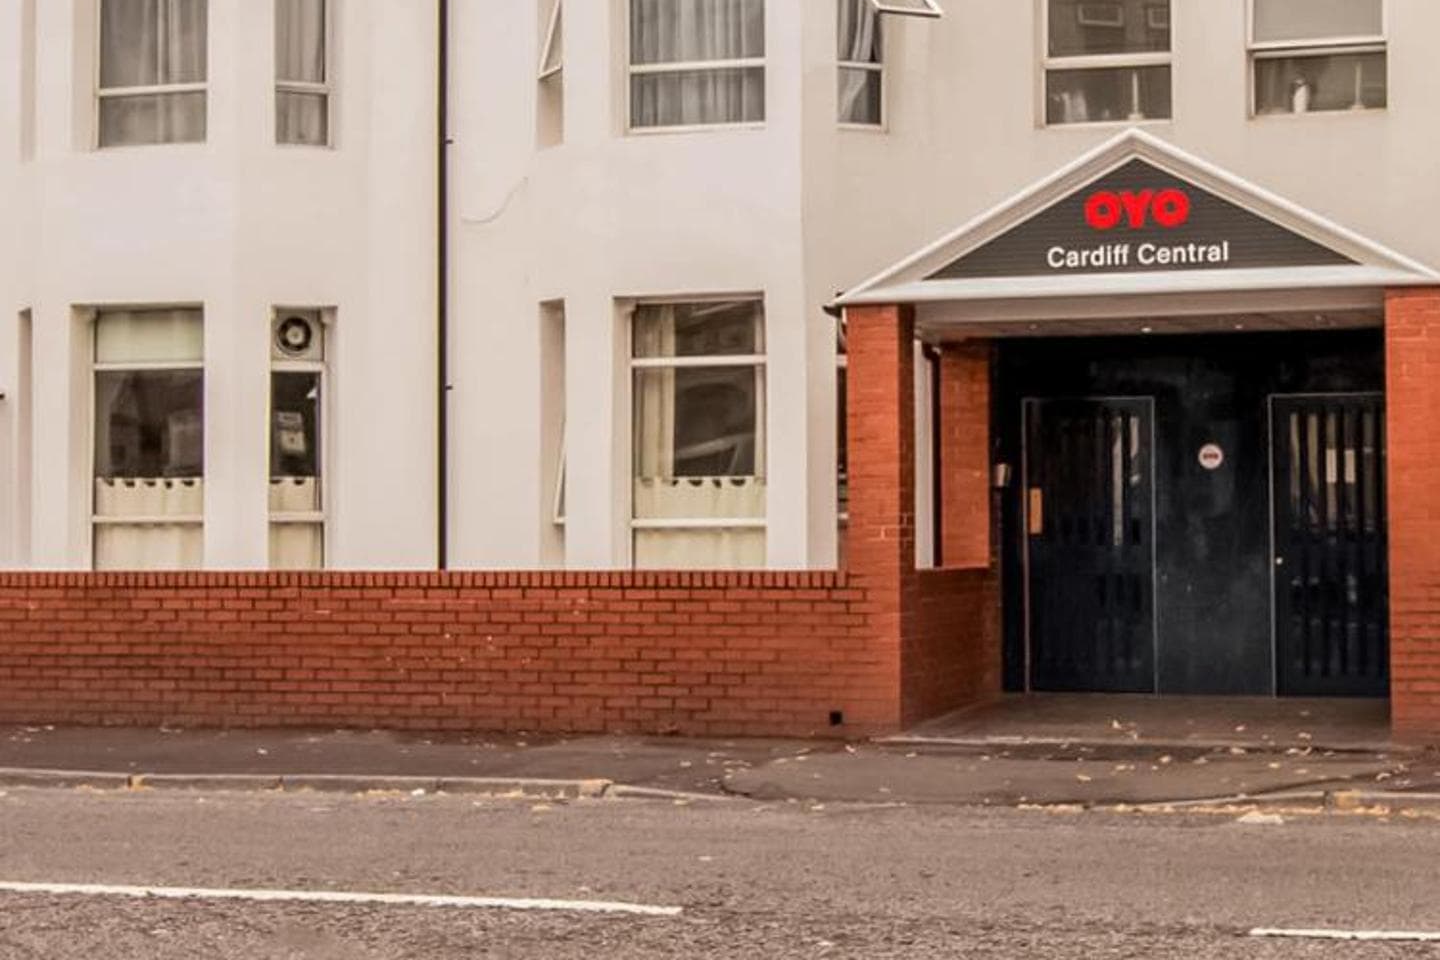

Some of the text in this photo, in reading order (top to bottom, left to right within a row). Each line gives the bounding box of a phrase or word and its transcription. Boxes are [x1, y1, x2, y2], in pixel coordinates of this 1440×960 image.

[1084, 188, 1190, 230] OYO
[1047, 240, 1229, 268] Cardiff Central
